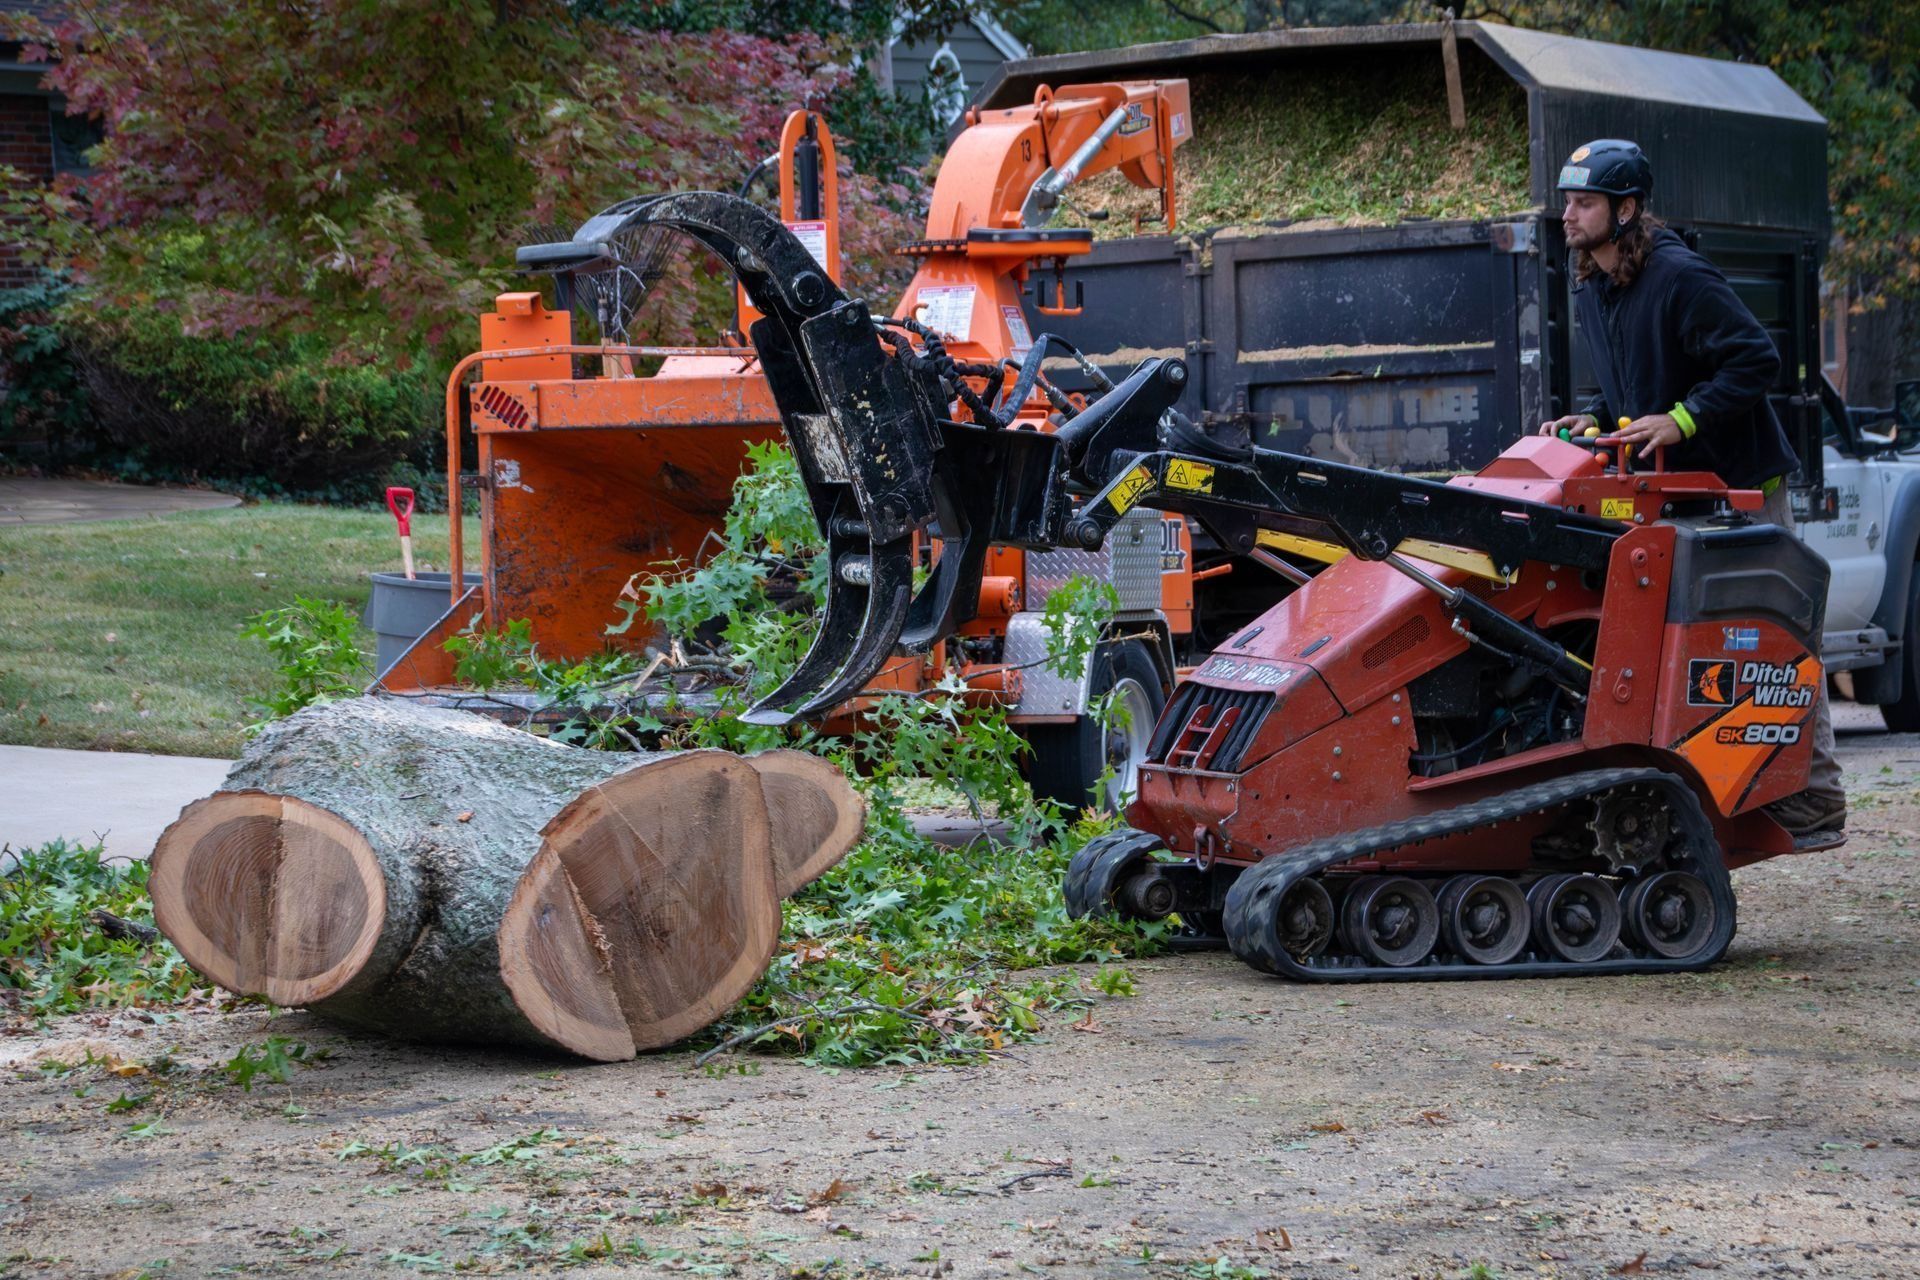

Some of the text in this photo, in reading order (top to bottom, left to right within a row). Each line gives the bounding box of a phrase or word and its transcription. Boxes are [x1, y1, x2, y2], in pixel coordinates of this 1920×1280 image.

[1021, 139, 1031, 162] 13
[1240, 663, 1295, 686] Witch
[1741, 662, 1798, 684] Ditch
[1754, 685, 1813, 706] Witch
[1716, 724, 1801, 744] SK800
